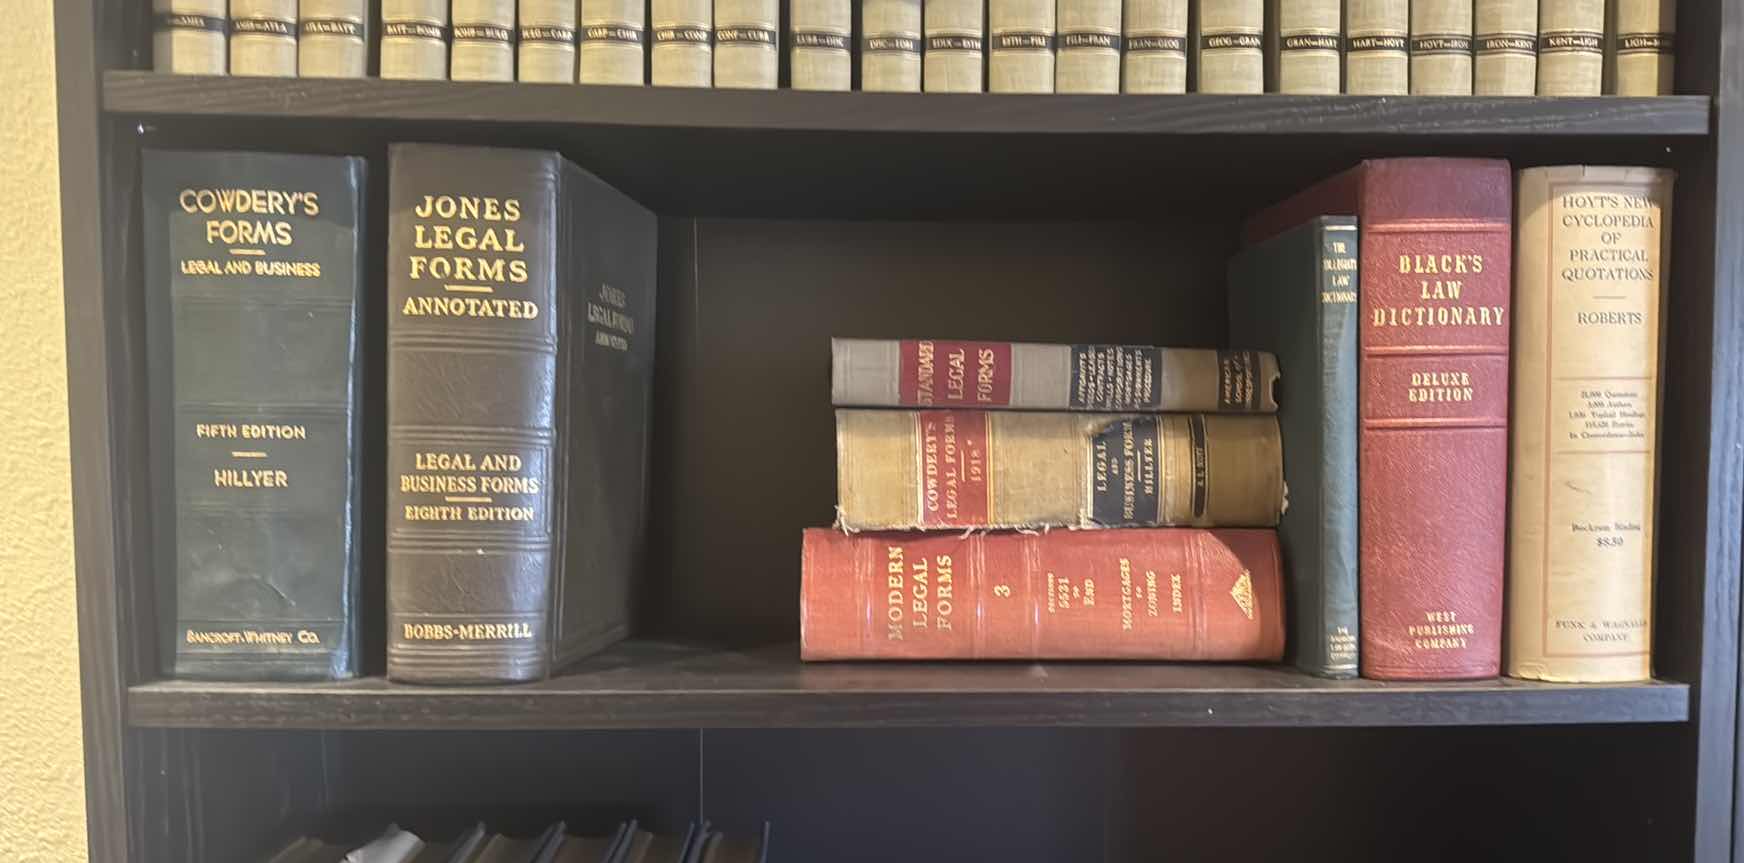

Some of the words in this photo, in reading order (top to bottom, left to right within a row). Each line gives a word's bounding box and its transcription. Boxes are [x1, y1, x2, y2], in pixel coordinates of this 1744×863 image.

[180, 188, 320, 216] COWDERY'S
[415, 195, 521, 222] JONES
[1562, 195, 1618, 209] HOYT'S
[1562, 214, 1655, 228] CYCLOPEDIA
[207, 219, 293, 246] FORMS
[414, 224, 525, 252] LEGAL
[1600, 231, 1622, 244] OF
[1399, 255, 1483, 273] BLACK'S
[1569, 249, 1649, 261] PRACTICAL
[181, 259, 223, 275] LEGAL
[224, 260, 252, 275] AND
[255, 261, 321, 278] BUSINESS
[409, 255, 528, 283] FORMS
[1561, 267, 1654, 282] QUOTATIONS
[1332, 274, 1350, 288] LAW
[1421, 280, 1463, 299] LAW
[402, 296, 539, 320] ANNOTATED
[1373, 307, 1504, 326] DICTIONARY
[1578, 312, 1642, 325] ROBERTS
[948, 348, 965, 400] LEGAL
[977, 348, 994, 402] FORMS
[1411, 373, 1470, 386] DELUXE
[1408, 388, 1473, 402] EDITION
[196, 423, 238, 438] FIFTH
[241, 424, 306, 440] EDITION
[415, 453, 476, 471] LEGAL
[480, 454, 522, 472] AND
[1096, 441, 1107, 492] LEGAL
[1144, 438, 1154, 494] HILLYER
[214, 469, 289, 487] HILLYER
[400, 474, 477, 493] BUSINESS
[481, 476, 540, 494] FORMS
[945, 467, 958, 519] LEGAL
[404, 505, 463, 521] EIGHTH
[467, 506, 535, 521] EDITION
[888, 546, 904, 640] MODERN
[912, 557, 928, 629] LEGAL
[937, 555, 953, 631] FORMS
[994, 584, 1011, 598] 3
[1083, 578, 1095, 608] END
[1120, 557, 1133, 632] MORTGAGES
[1145, 570, 1158, 617] ZONING
[1171, 573, 1182, 614] INDEX
[1425, 611, 1456, 622] WEST
[404, 623, 533, 640] BOBBS-MERRILL
[1408, 624, 1474, 636] PUBLISHING
[1415, 638, 1467, 648] COMPANY
